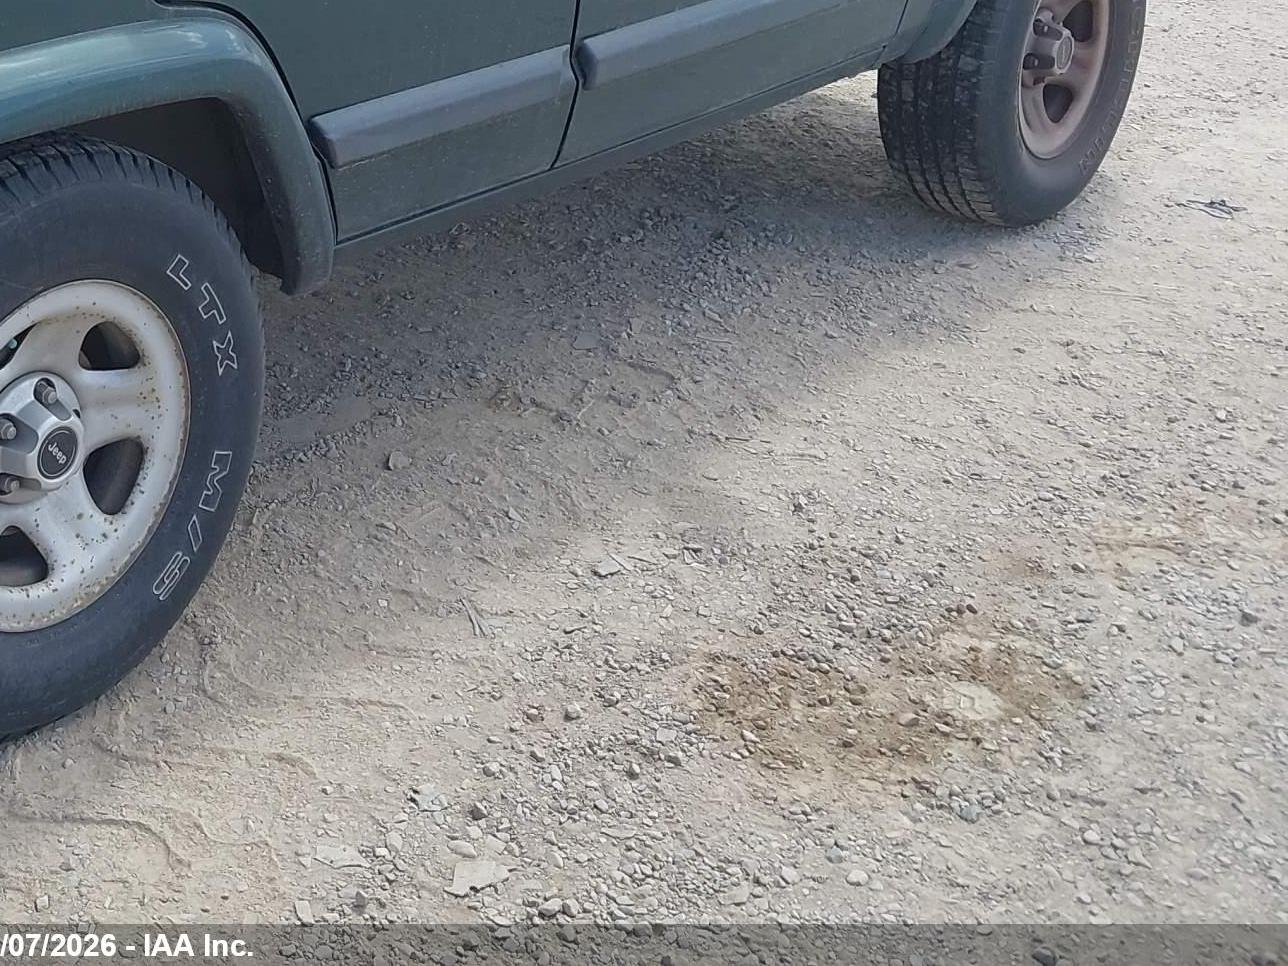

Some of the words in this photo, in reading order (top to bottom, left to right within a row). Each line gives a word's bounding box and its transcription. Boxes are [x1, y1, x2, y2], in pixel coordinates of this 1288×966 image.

[166, 253, 239, 376] LTX
[47, 442, 67, 464] Jeep
[152, 450, 233, 601] M/S
